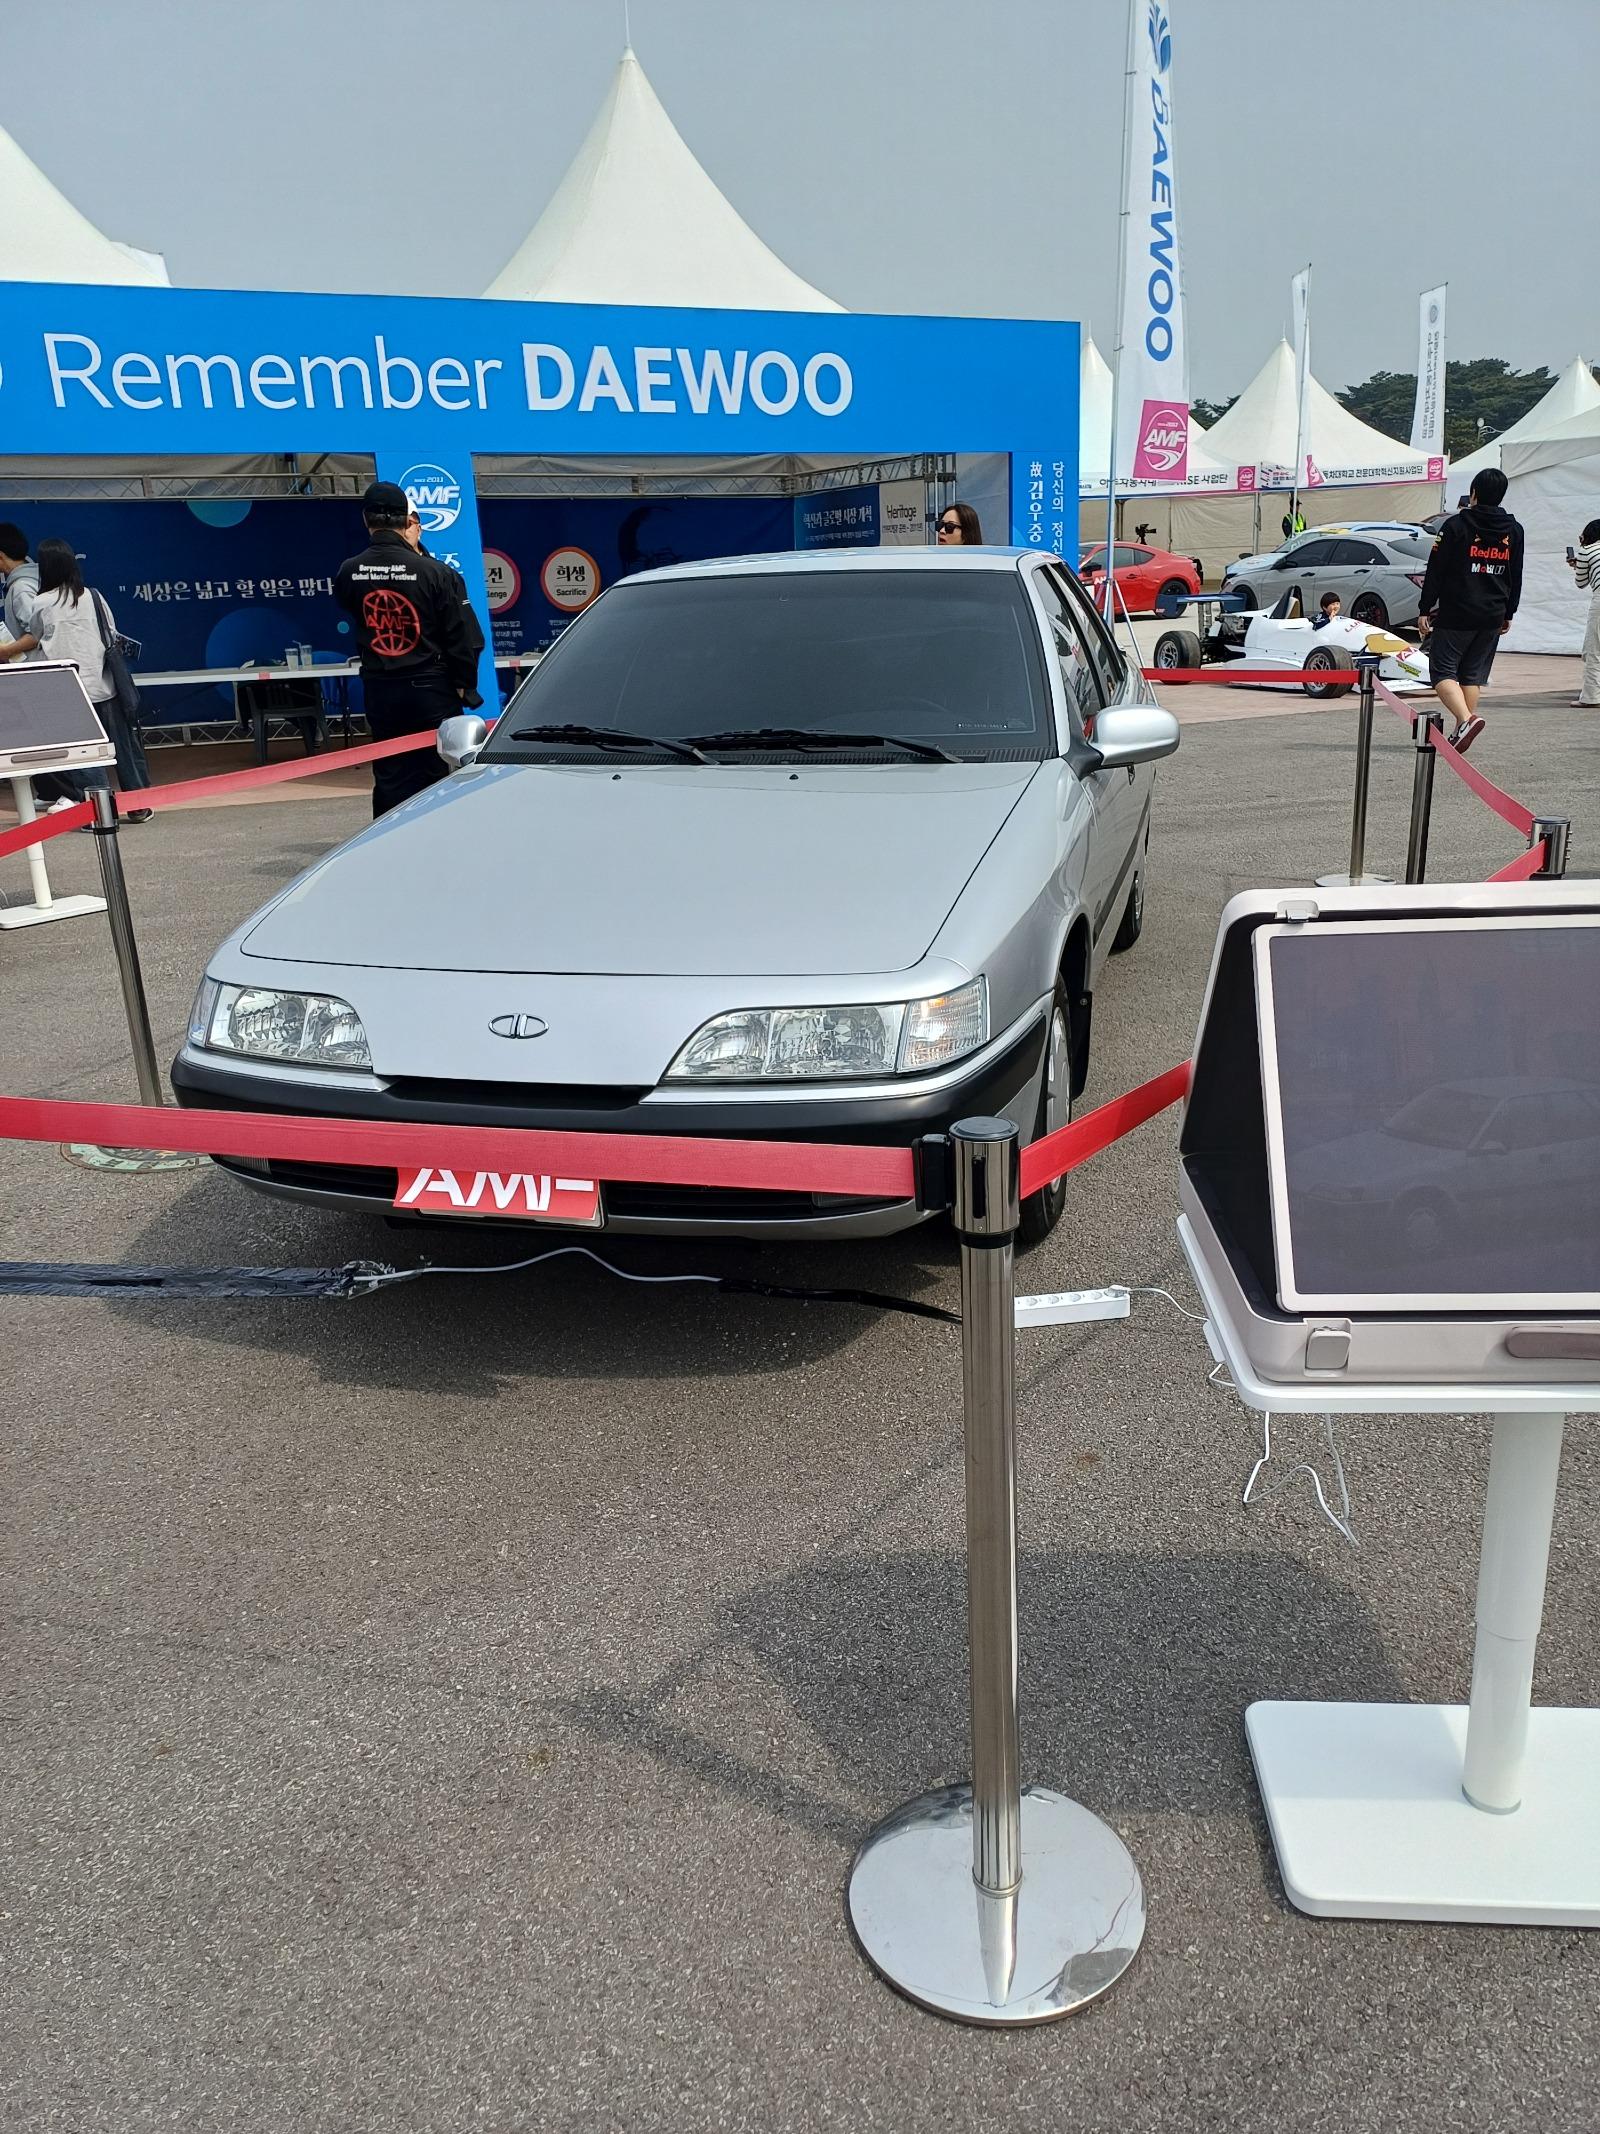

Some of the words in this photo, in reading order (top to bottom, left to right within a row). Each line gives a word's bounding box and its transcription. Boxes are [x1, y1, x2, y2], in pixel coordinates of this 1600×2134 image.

[43, 332, 503, 410] Remember
[521, 342, 854, 417] DAEWOO
[1144, 428, 1187, 448] AMF
[1030, 460, 1043, 478] 故
[403, 485, 461, 505] AMF
[1051, 460, 1065, 513] 당신의
[886, 505, 917, 521] Heritage
[1027, 480, 1044, 543] 김우중
[1470, 545, 1490, 558] Red
[556, 565, 586, 582] 희생
[133, 581, 191, 602] 세상은
[195, 581, 232, 600] 넓고
[235, 578, 255, 598] 할
[259, 578, 294, 598] 일은
[298, 577, 335, 596] 많다
[556, 588, 587, 597] Sacrifice
